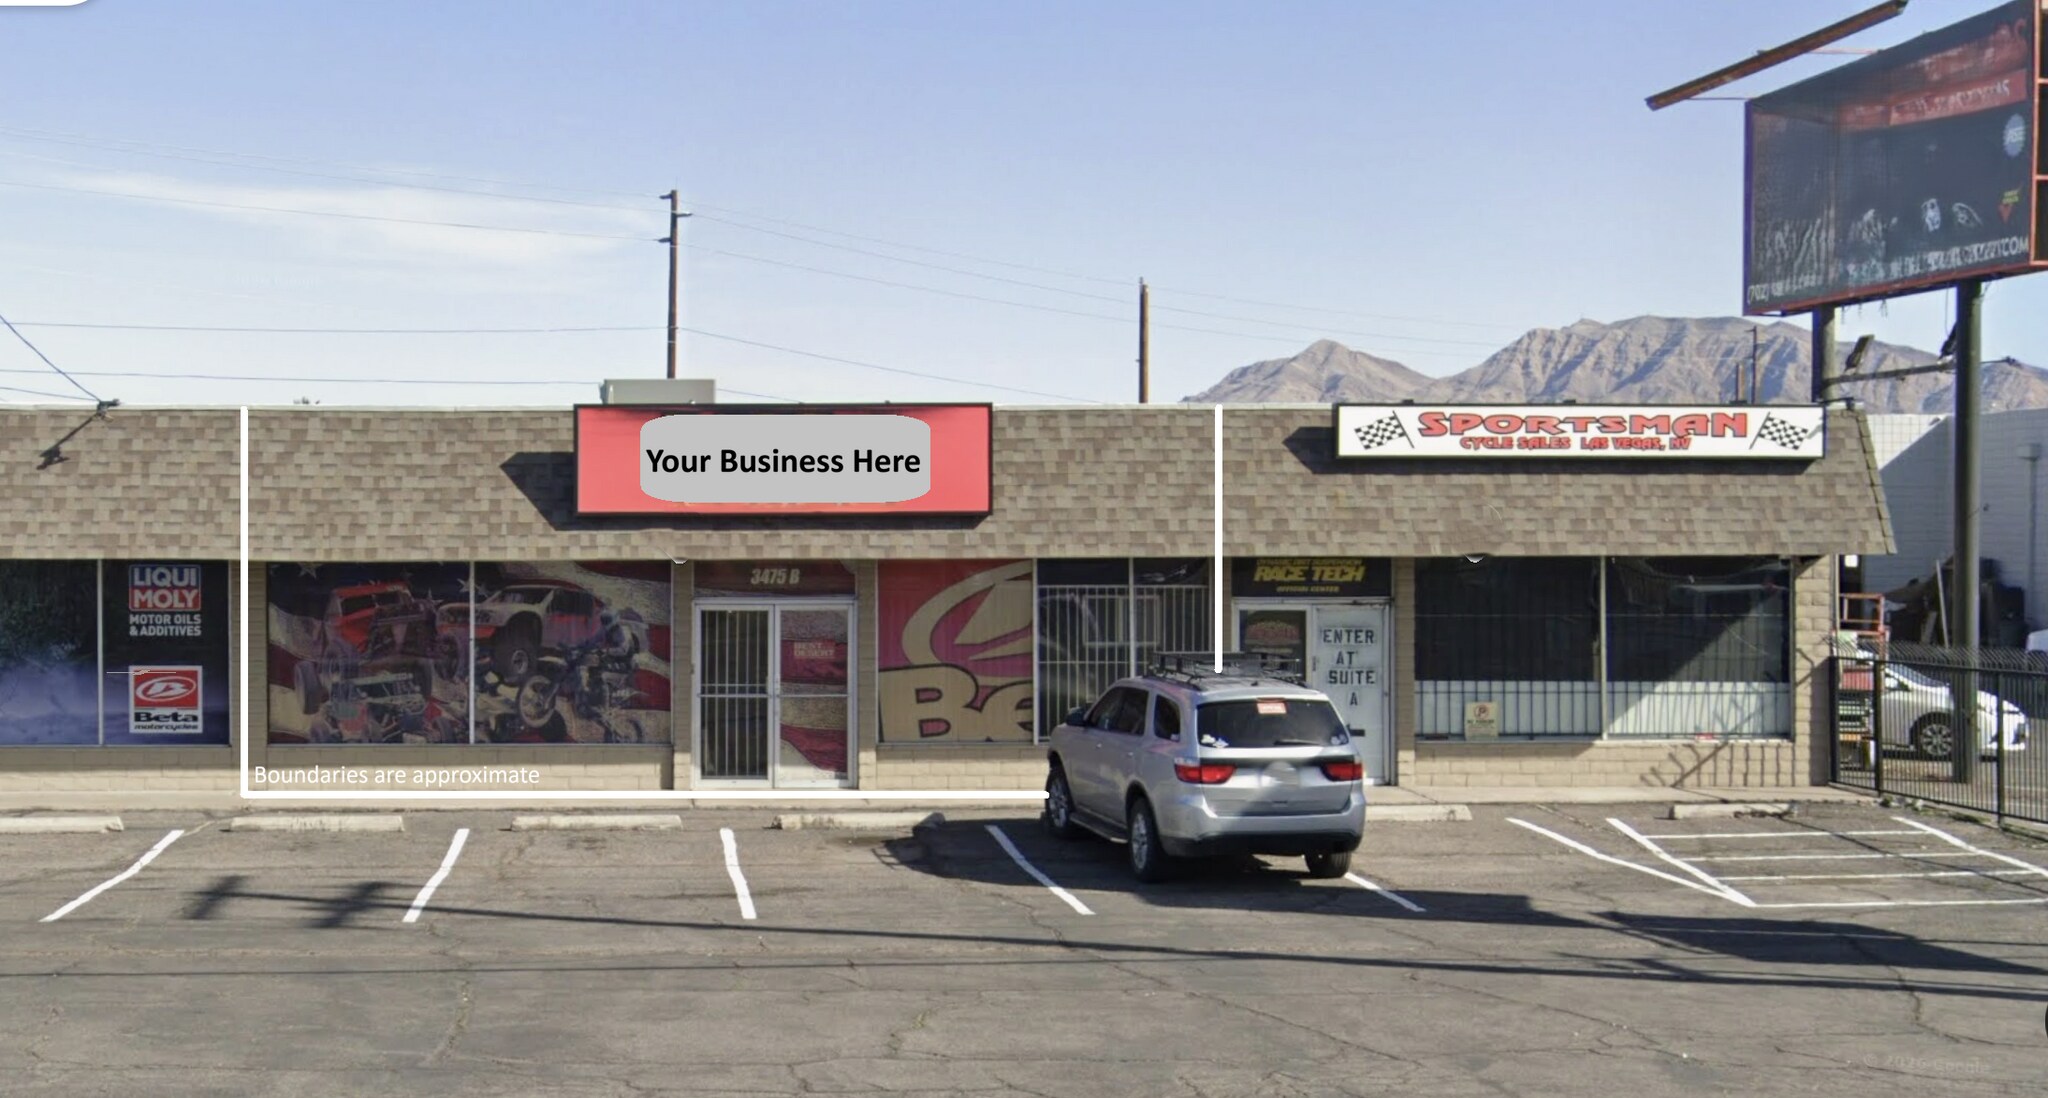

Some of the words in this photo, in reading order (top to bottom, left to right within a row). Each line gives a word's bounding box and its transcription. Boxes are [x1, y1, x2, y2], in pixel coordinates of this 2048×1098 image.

[1418, 411, 1748, 438] SPORTSMAN
[1459, 436, 1514, 450] CYCLE
[1517, 436, 1572, 450] SALES
[1580, 436, 1609, 450] LAS
[1611, 436, 1666, 451] VEGAS,
[1669, 436, 1692, 450] NV
[134, 566, 197, 587] LIQUI
[751, 568, 787, 585] 3475
[789, 568, 801, 585] B
[1253, 565, 1308, 581] RACE
[1311, 565, 1367, 581] TECH
[134, 588, 199, 608] MOLY
[129, 613, 172, 625] MOTOR
[173, 613, 202, 625] OILS
[129, 625, 138, 636] &
[139, 625, 202, 636] ADDITIVES
[1322, 629, 1375, 644] ENTER
[1336, 651, 1355, 666] AT
[1328, 670, 1376, 685] SUITE
[1349, 691, 1358, 706] A
[134, 711, 199, 723] Beta
[134, 723, 199, 731] motorcycles
